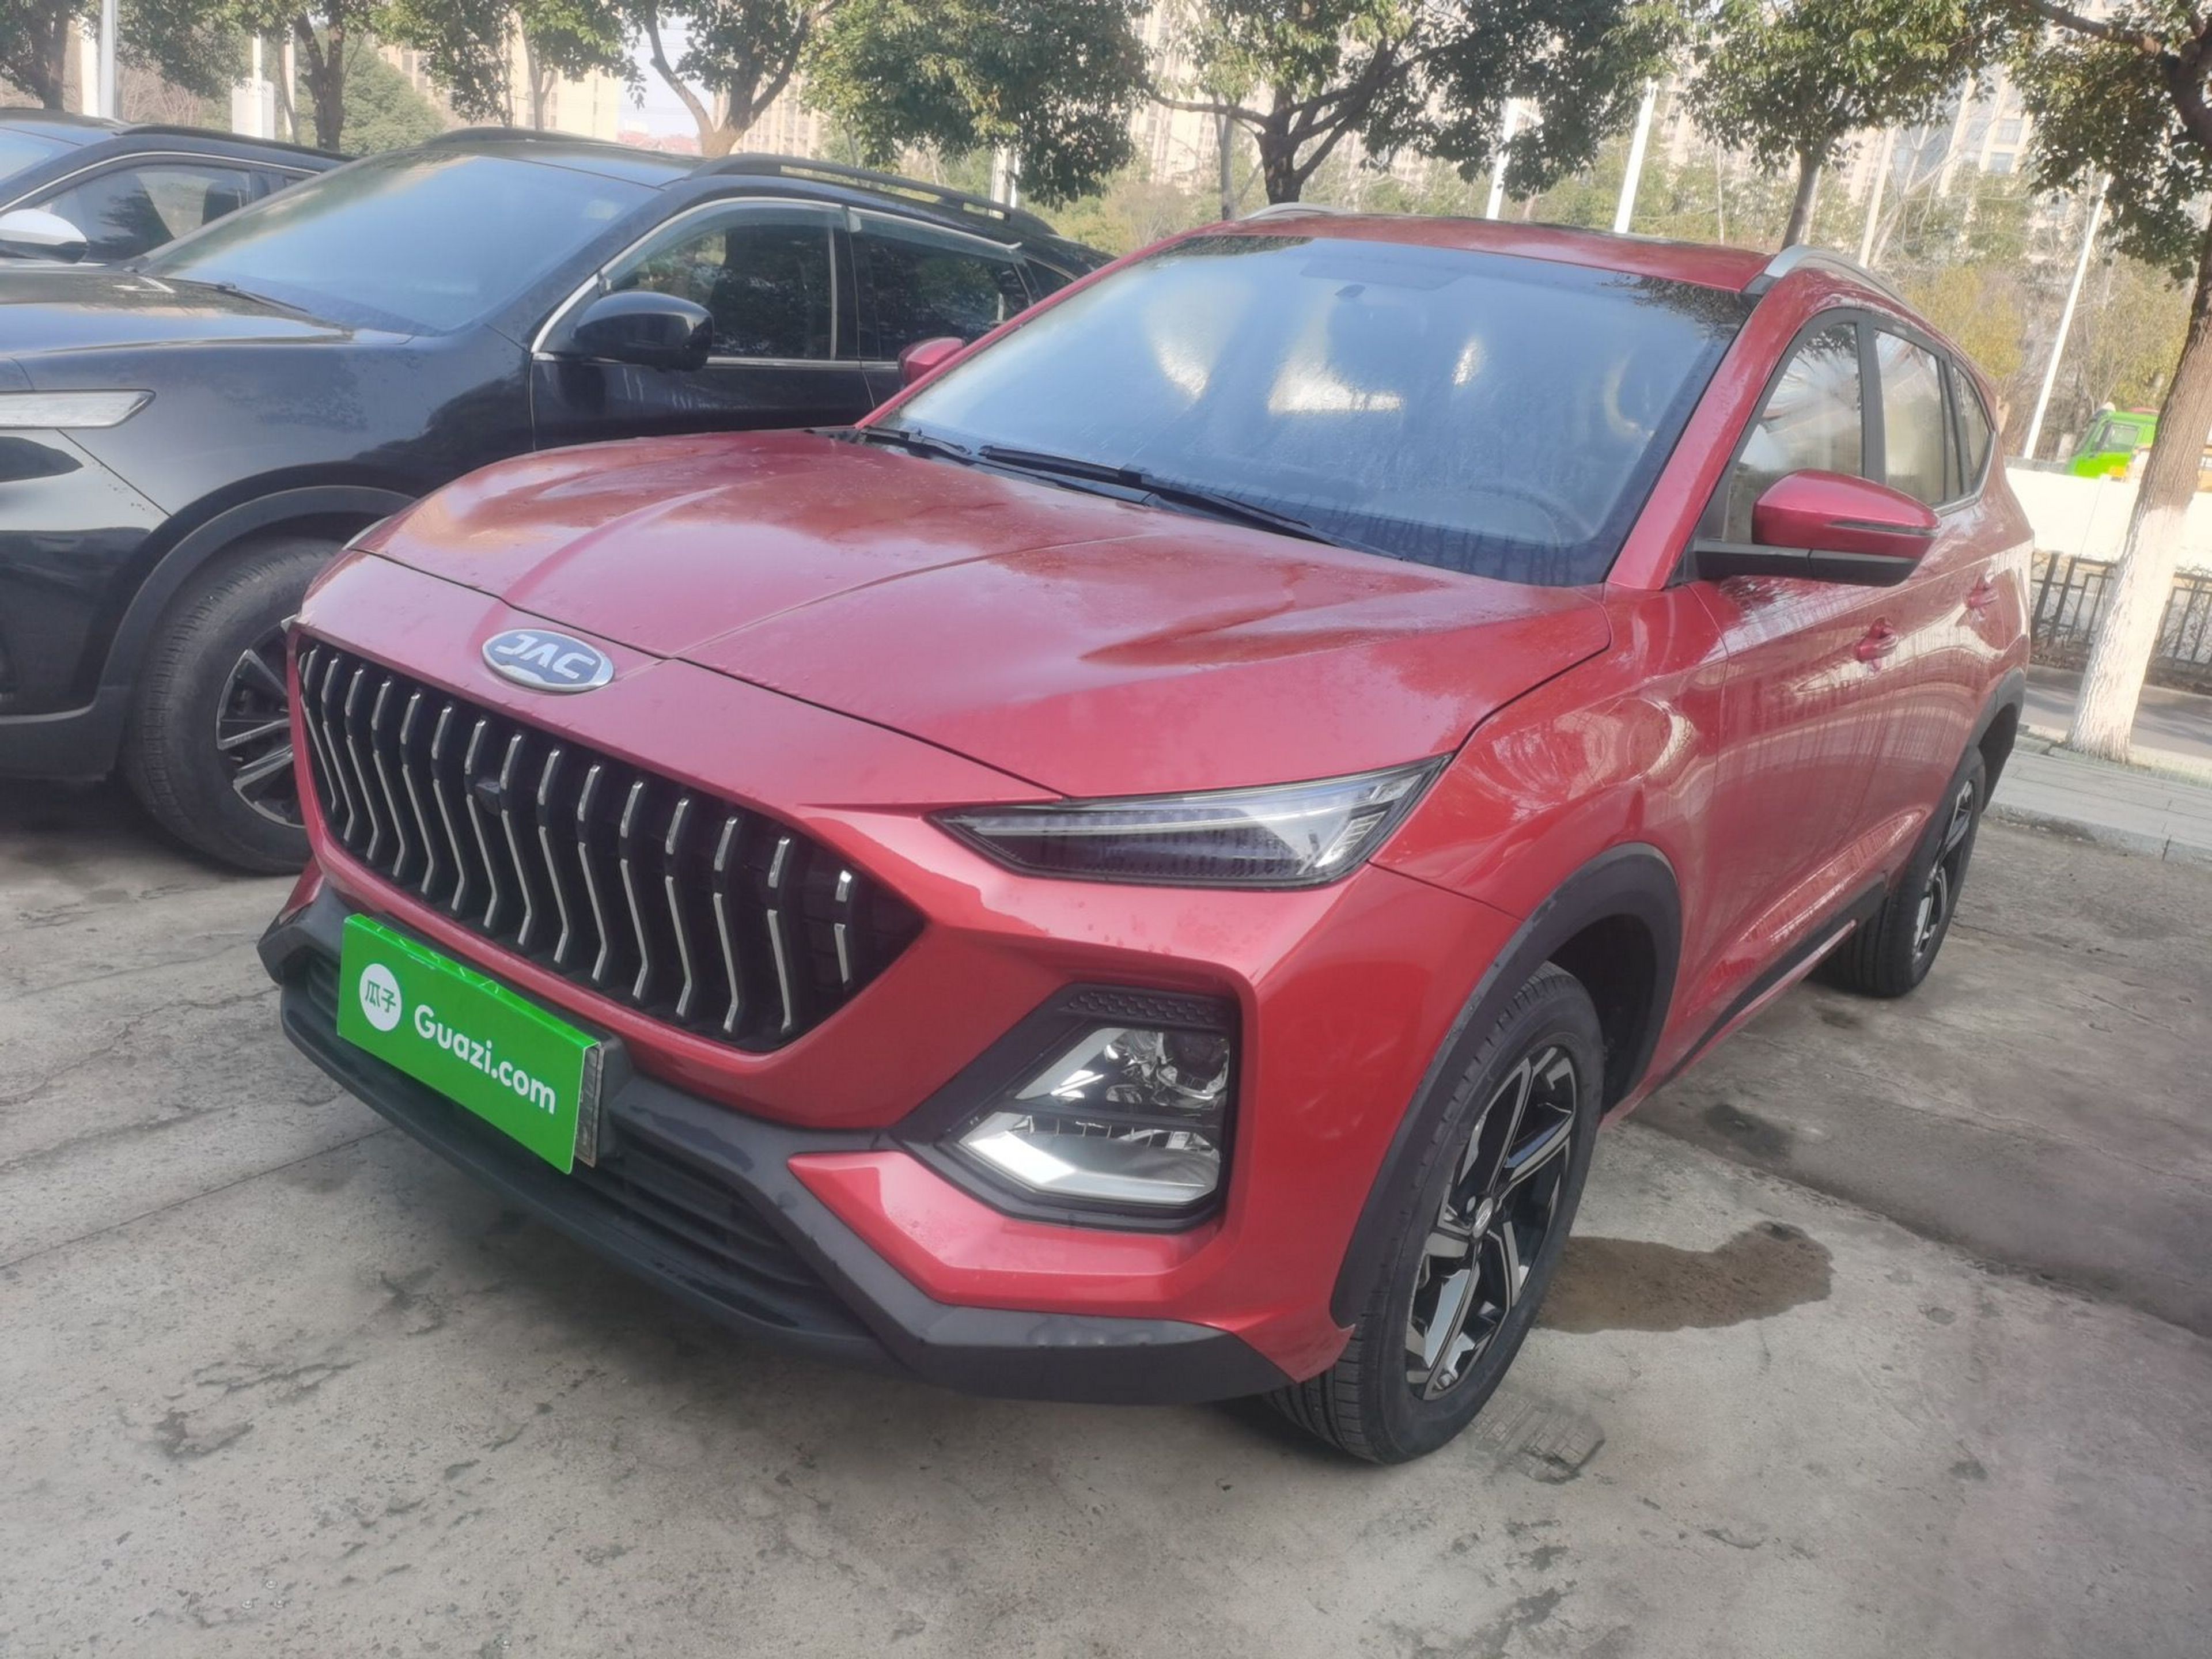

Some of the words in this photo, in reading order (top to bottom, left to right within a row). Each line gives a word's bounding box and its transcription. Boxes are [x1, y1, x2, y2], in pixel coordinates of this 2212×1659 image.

[495, 635, 596, 679] JAC
[365, 980, 396, 1013] 瓜子
[415, 1005, 555, 1114] Guazi.com
